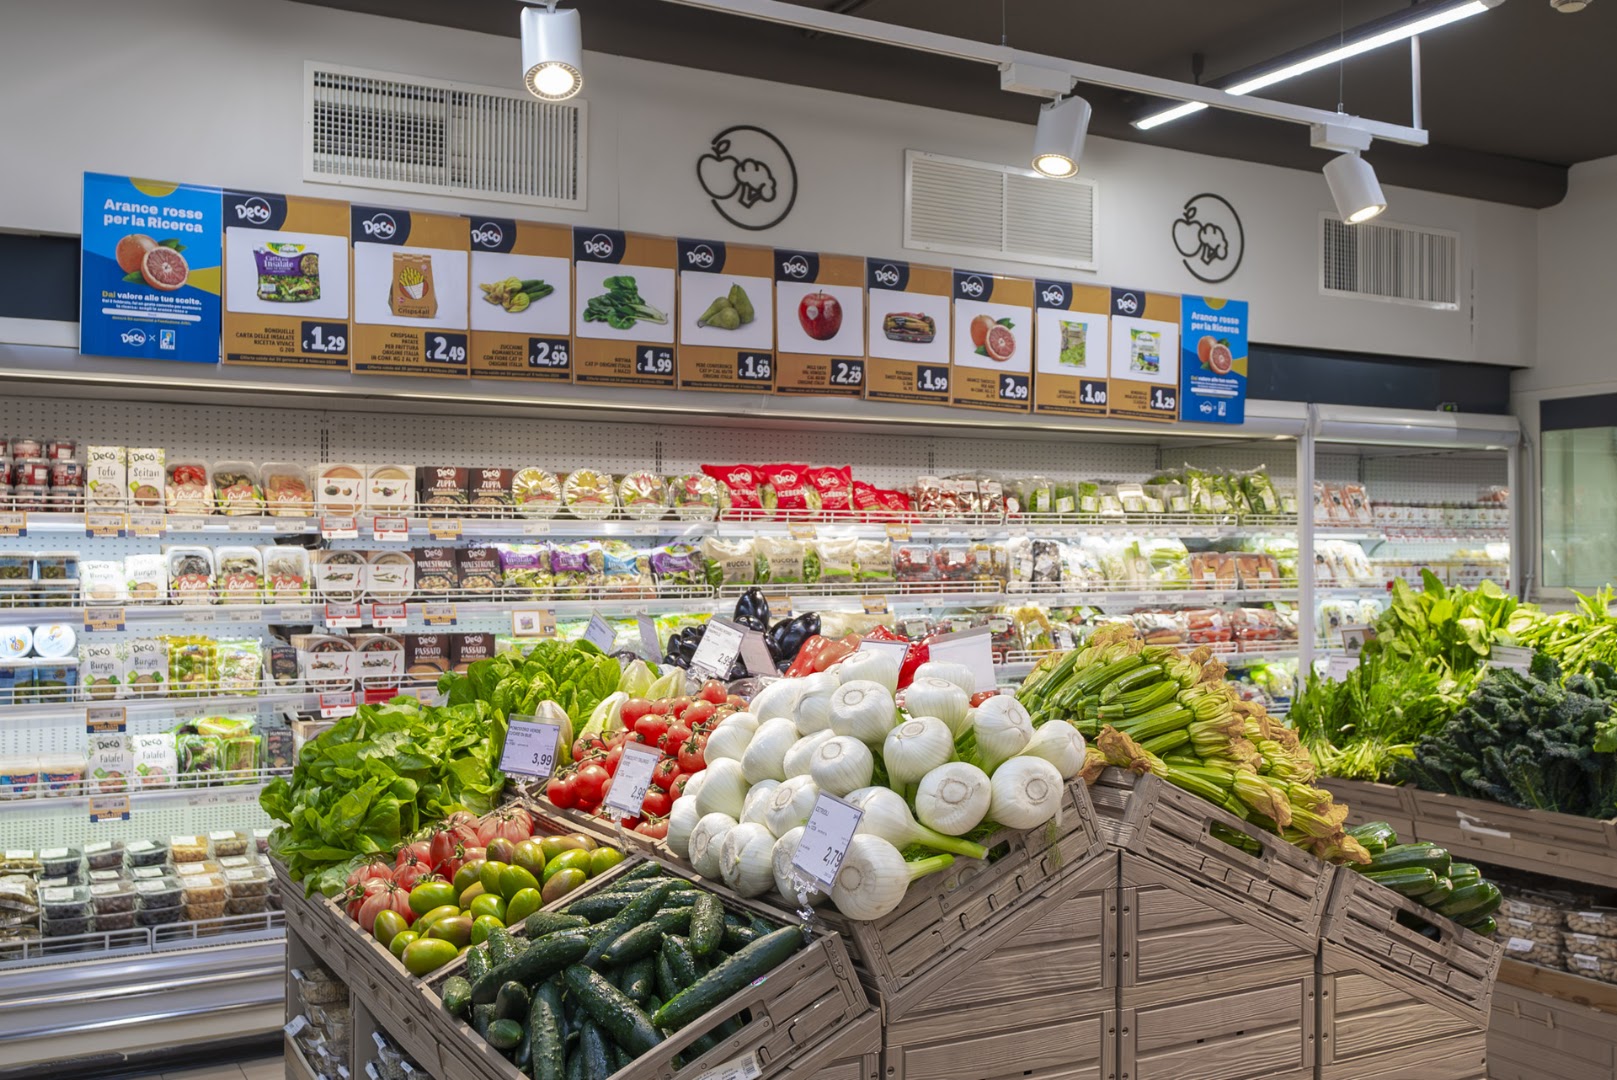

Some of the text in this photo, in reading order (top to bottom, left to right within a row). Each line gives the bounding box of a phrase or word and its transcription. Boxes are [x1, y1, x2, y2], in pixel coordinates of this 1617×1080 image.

[104, 199, 203, 220] Arance rosse
[104, 214, 203, 233] per la Ricerca
[117, 292, 143, 300] valore
[144, 293, 159, 302] alle
[1191, 312, 1217, 322] Arance
[1191, 322, 1203, 331] per
[1204, 323, 1211, 331] la
[311, 326, 345, 352] 1,29
[434, 336, 465, 362] 2,49
[537, 342, 568, 366] 2,99
[644, 350, 672, 373] 1,99
[745, 356, 770, 379] 1,99
[836, 363, 862, 384] 2,29
[924, 370, 947, 390] 1,99
[1005, 377, 1028, 399] 2,99
[1085, 384, 1106, 404] 1,00
[1155, 389, 1175, 409] 1,29
[92, 452, 115, 461] Decò
[132, 453, 155, 462] Decò
[97, 466, 116, 477] Tofu
[134, 467, 159, 477] Seitan
[436, 479, 457, 487] ZUPPA
[417, 560, 452, 568] MINESTRONE
[726, 560, 751, 568] RUCOLA
[87, 648, 110, 657] Decò
[132, 644, 154, 653] Decò
[415, 647, 441, 655] PASSATO
[461, 646, 486, 654] PASSATO
[90, 661, 114, 671] Burger
[134, 657, 158, 666] Burger
[97, 740, 120, 750] Decò
[100, 753, 124, 763] Falafel
[143, 750, 166, 759] Falafel
[532, 752, 552, 766] 3,99
[833, 846, 854, 868] 2,79
